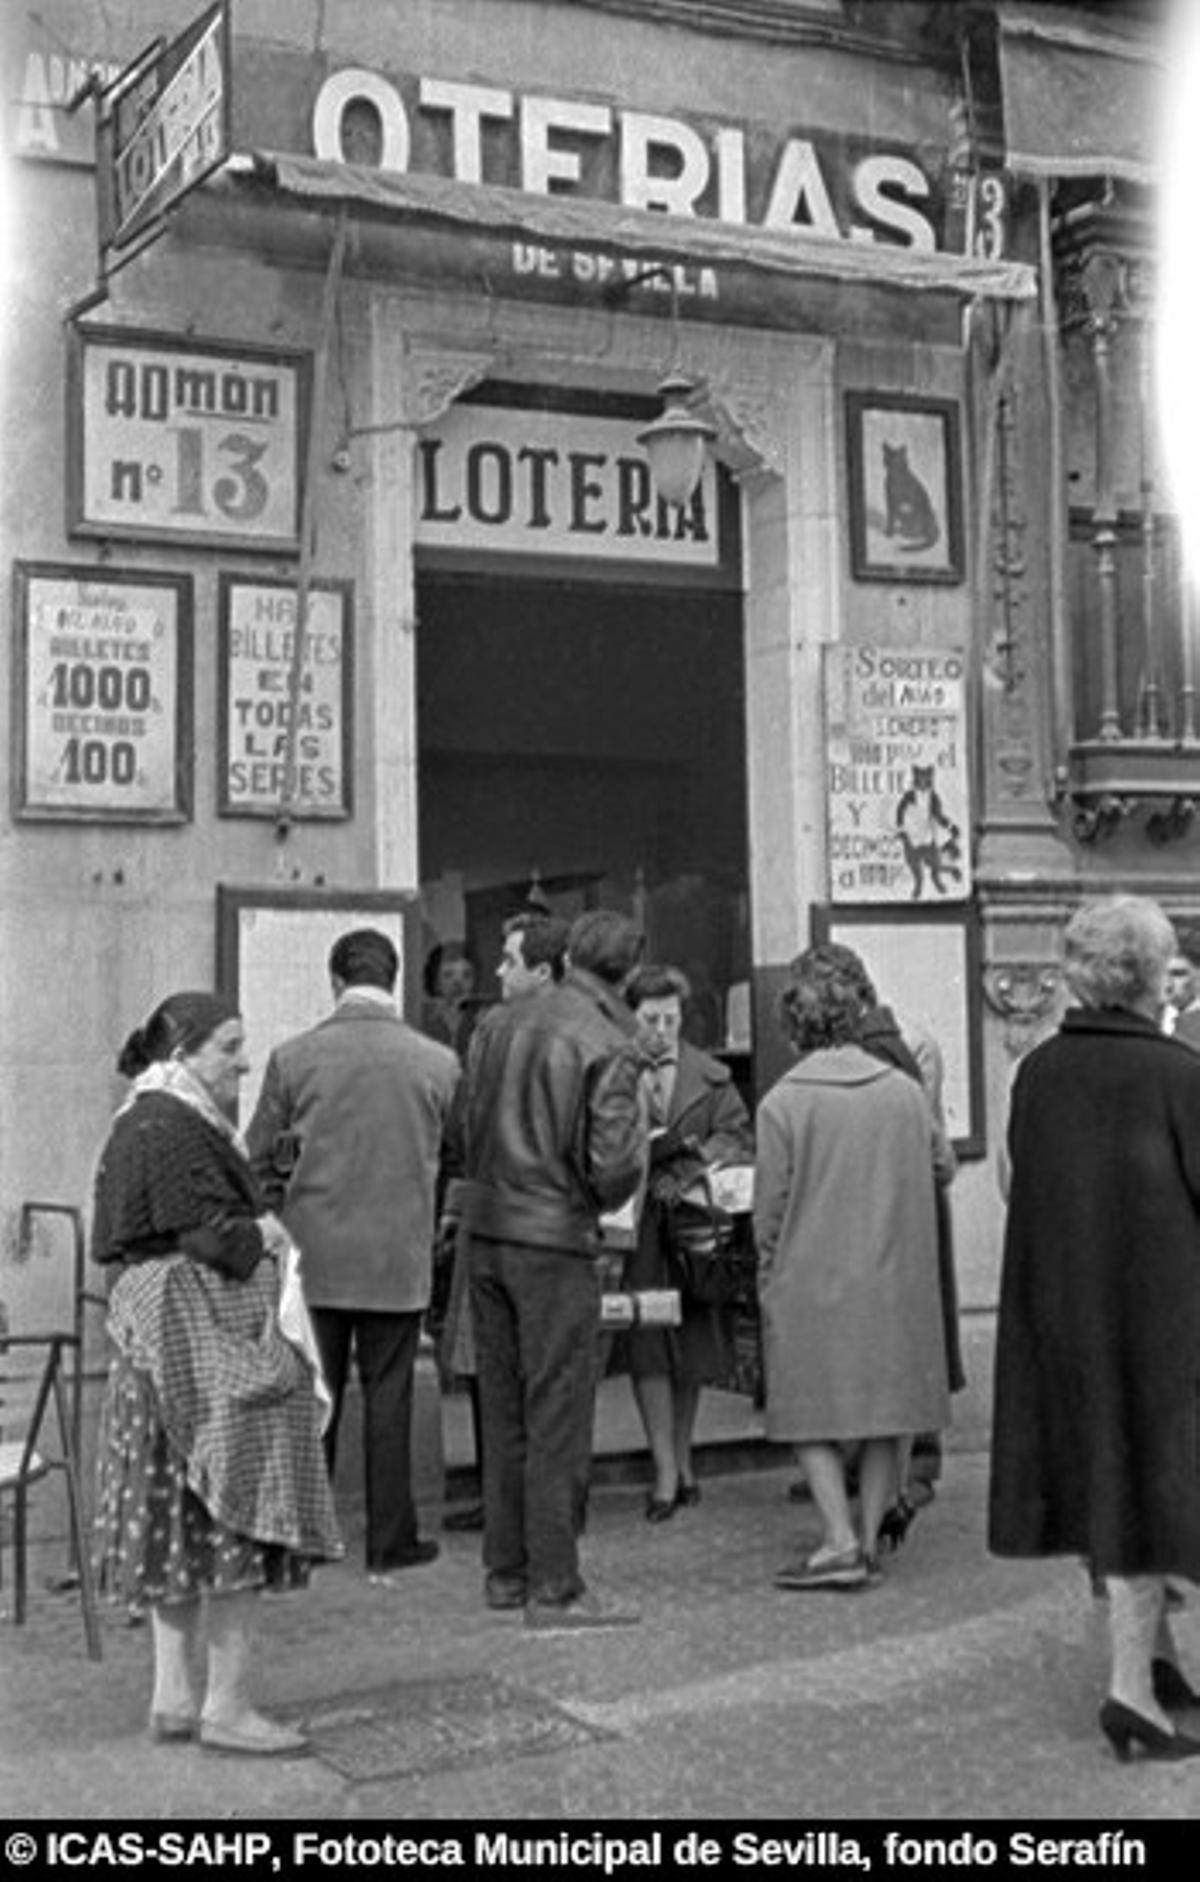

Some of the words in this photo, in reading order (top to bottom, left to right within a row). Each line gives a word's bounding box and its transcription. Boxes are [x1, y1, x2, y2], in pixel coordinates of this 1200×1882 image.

[165, 427, 270, 522] 13
[48, 663, 151, 713] 1000
[235, 699, 333, 730] TODAS
[60, 738, 136, 785] 100
[847, 800, 867, 827] Y
